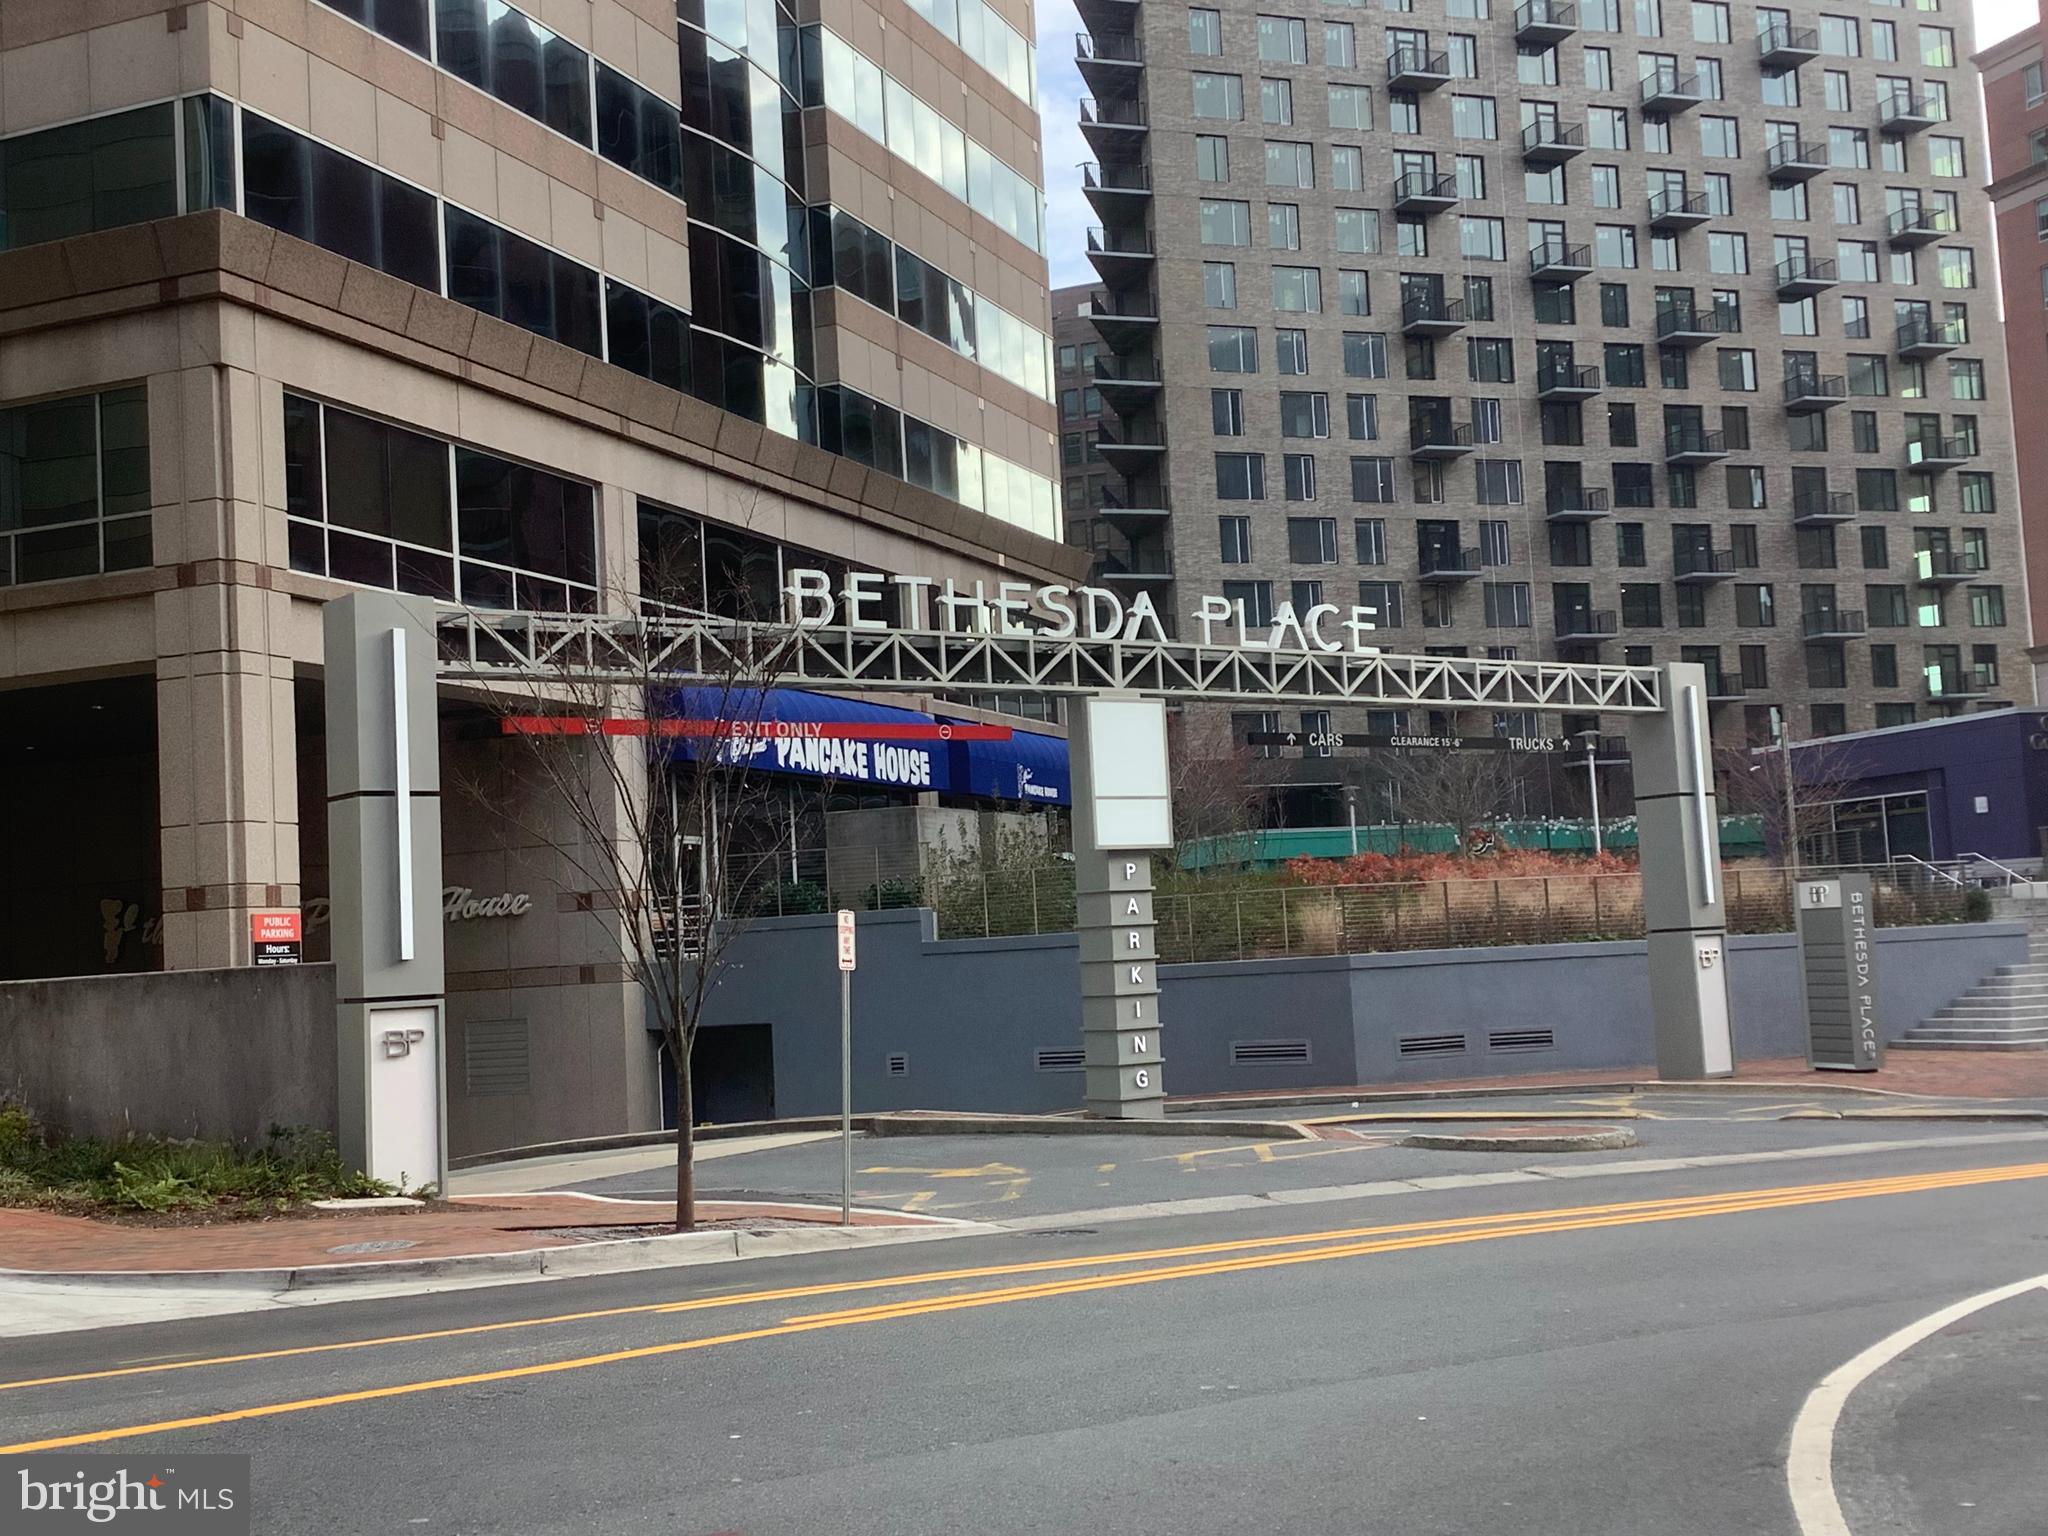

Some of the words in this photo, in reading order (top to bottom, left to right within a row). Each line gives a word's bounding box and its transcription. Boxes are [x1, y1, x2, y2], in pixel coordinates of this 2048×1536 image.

[783, 568, 1168, 643] BETHESDA
[1191, 595, 1380, 654] PLACE
[732, 721, 772, 737] EXIT
[776, 722, 823, 738] ONLY
[1309, 733, 1343, 747] CARS
[1390, 736, 1440, 747] CLEARANCE
[1509, 737, 1554, 751] TRUCKS
[775, 737, 869, 779] PANCAKE
[873, 742, 931, 786] HOUSE
[442, 886, 532, 921] House
[263, 917, 291, 927] PUBLIC
[260, 929, 295, 939] PARKING
[1850, 891, 1871, 988] BETHESDA
[265, 944, 290, 954] Hours:
[1126, 862, 1149, 1088] PARKING
[1859, 995, 1876, 1052] PLACE
[382, 1029, 425, 1059] BP
